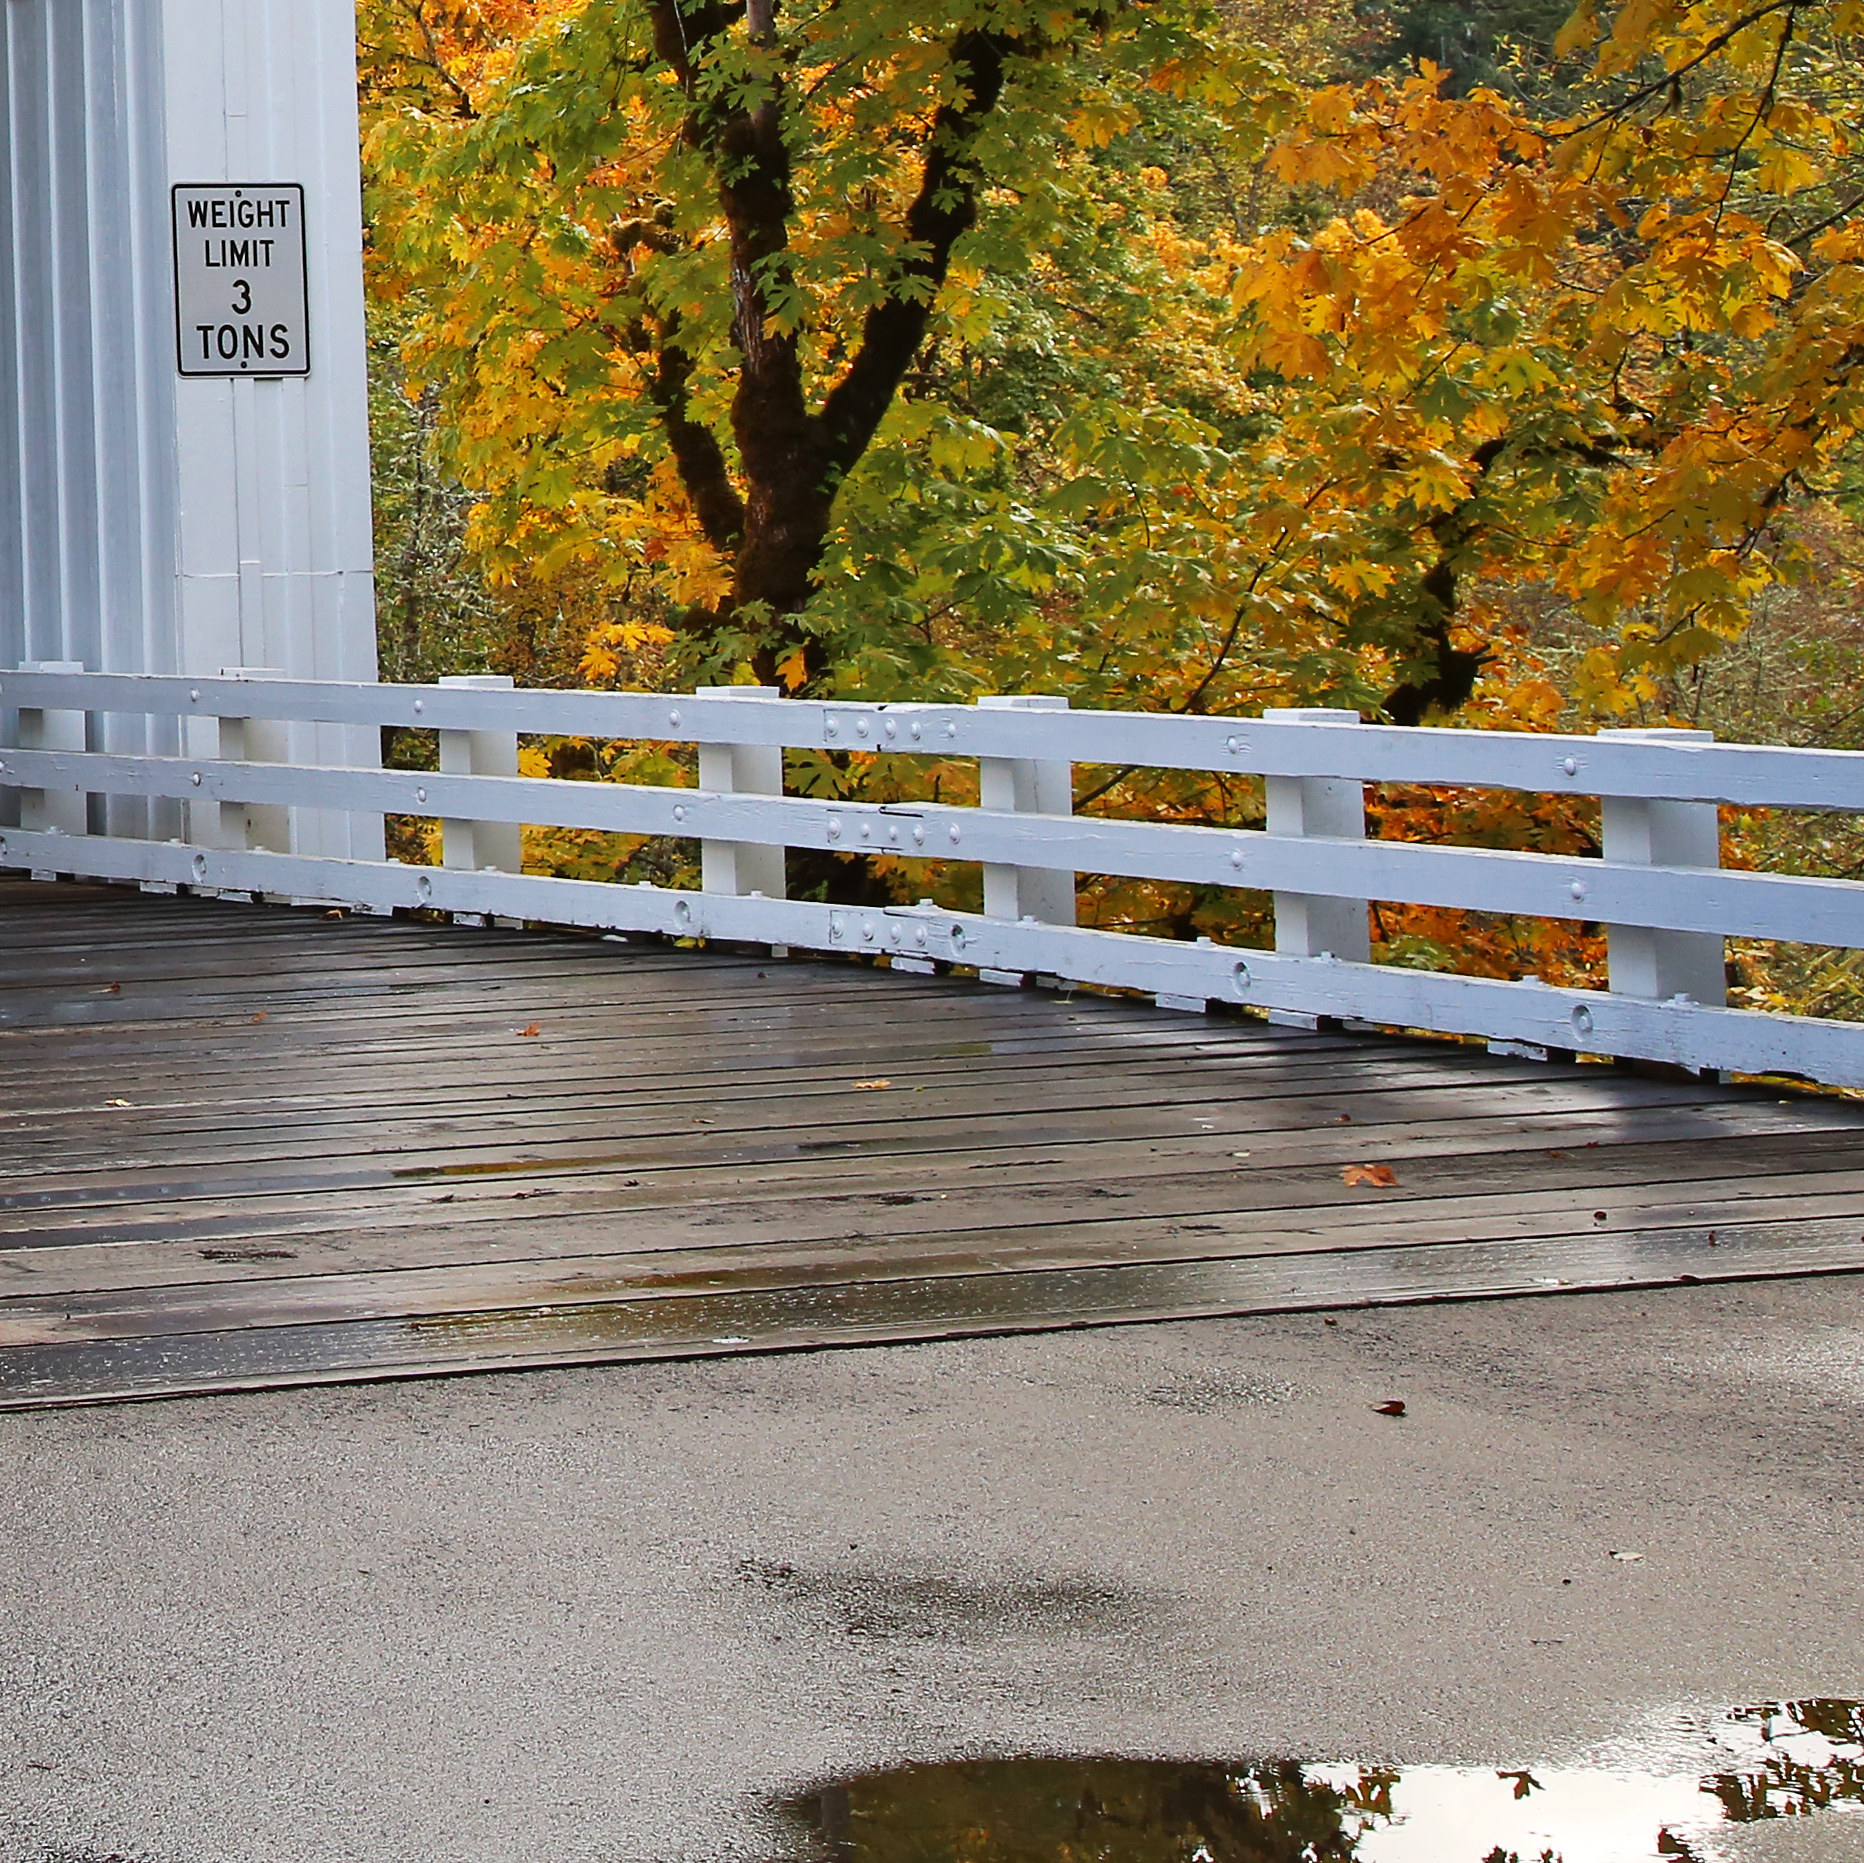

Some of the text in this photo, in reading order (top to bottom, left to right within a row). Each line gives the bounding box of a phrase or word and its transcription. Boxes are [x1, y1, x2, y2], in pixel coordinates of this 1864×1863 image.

[187, 199, 291, 229] WEIGHT
[204, 239, 275, 268] LIMIT
[231, 279, 252, 315] 3
[195, 323, 290, 360] TONS
